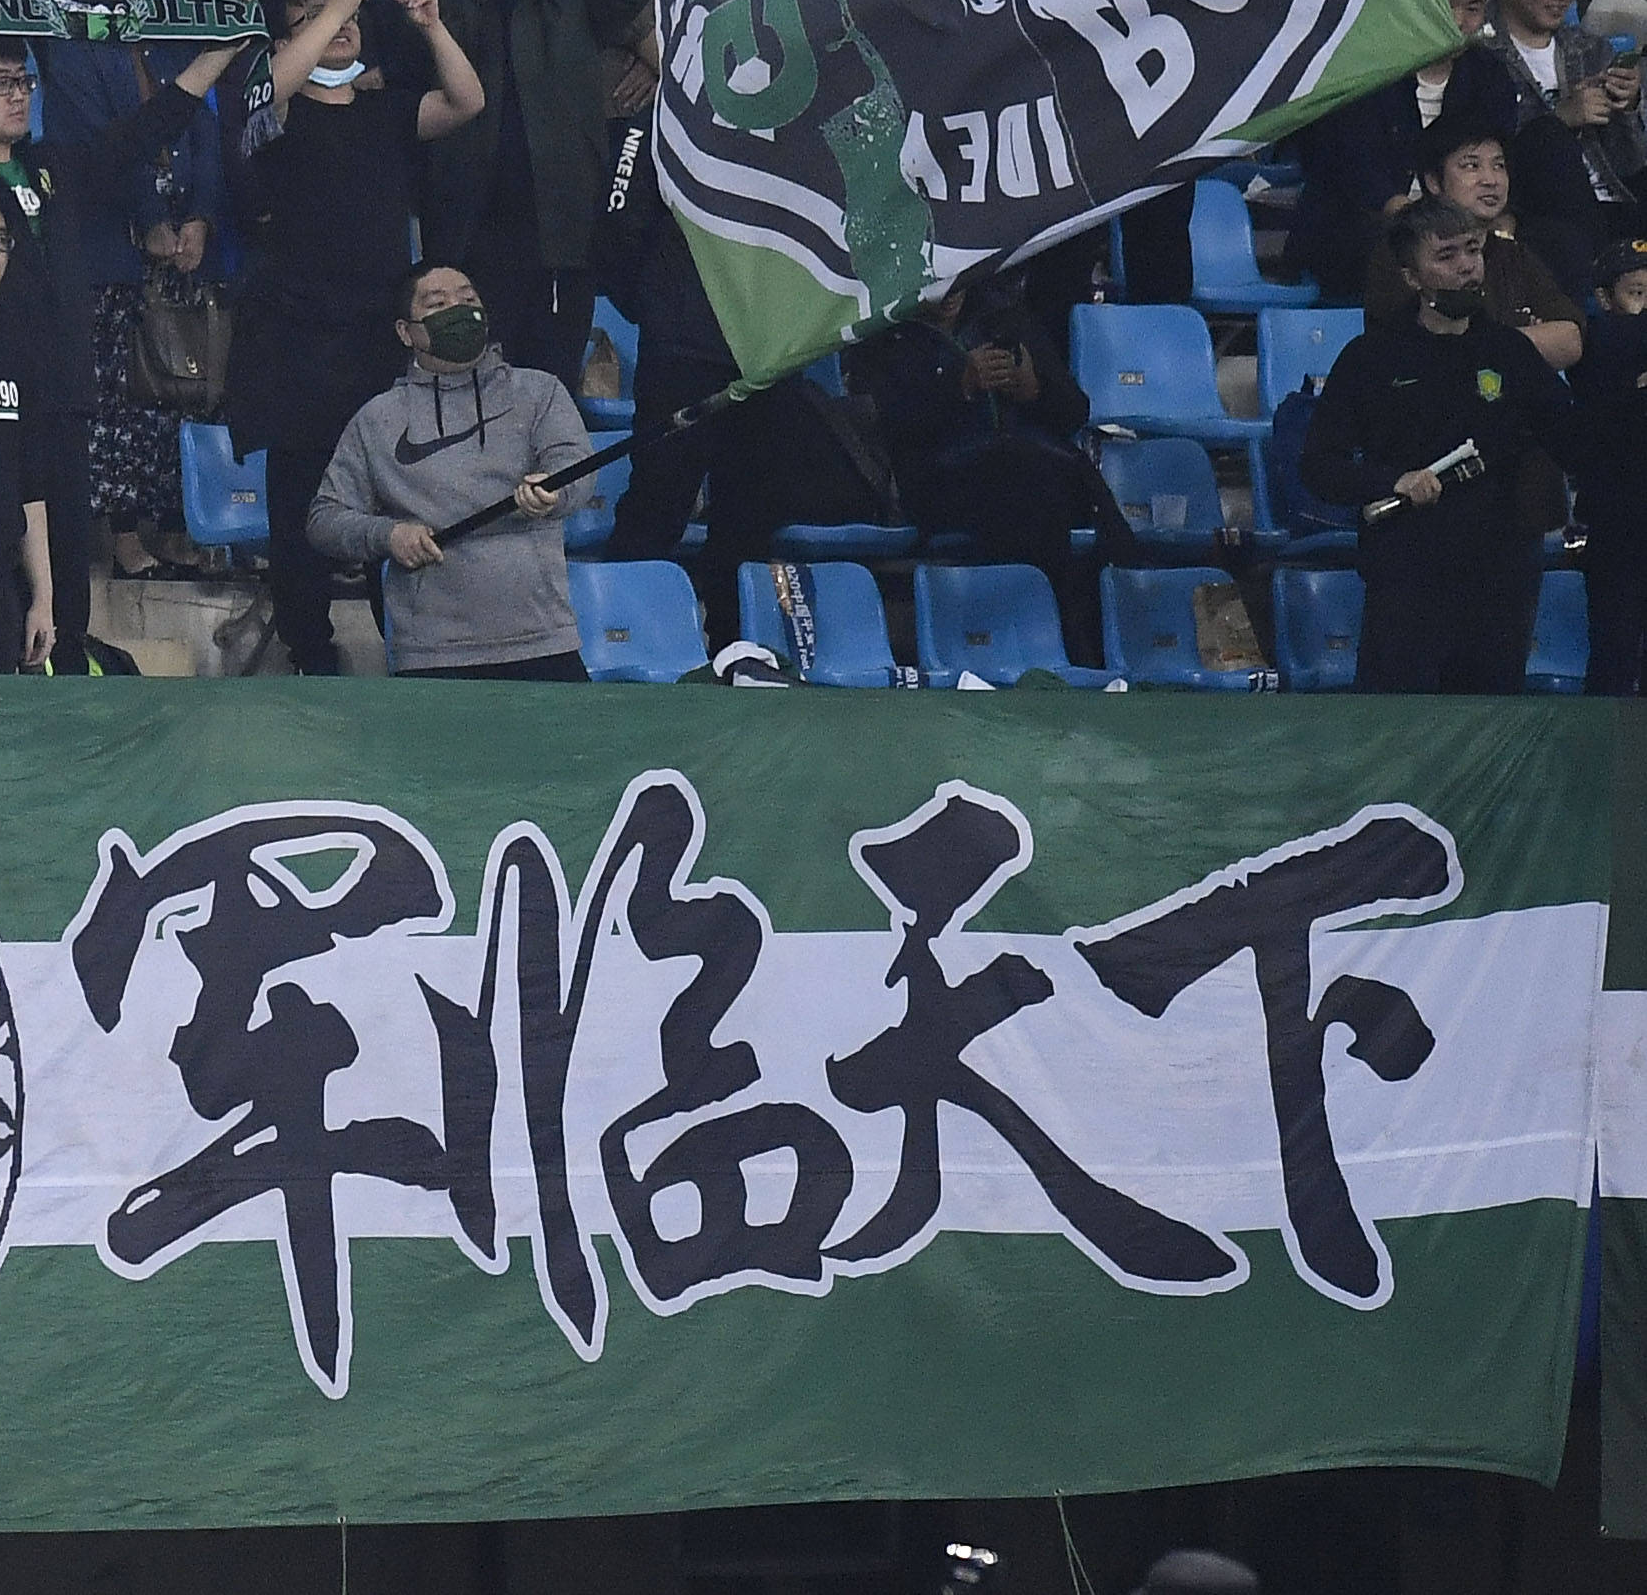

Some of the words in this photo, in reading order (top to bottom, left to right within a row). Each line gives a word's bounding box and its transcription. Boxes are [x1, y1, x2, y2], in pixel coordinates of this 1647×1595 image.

[616, 127, 645, 177] NIKE
[607, 176, 630, 213] F.C.
[67, 767, 1464, 1400] 军临天下
